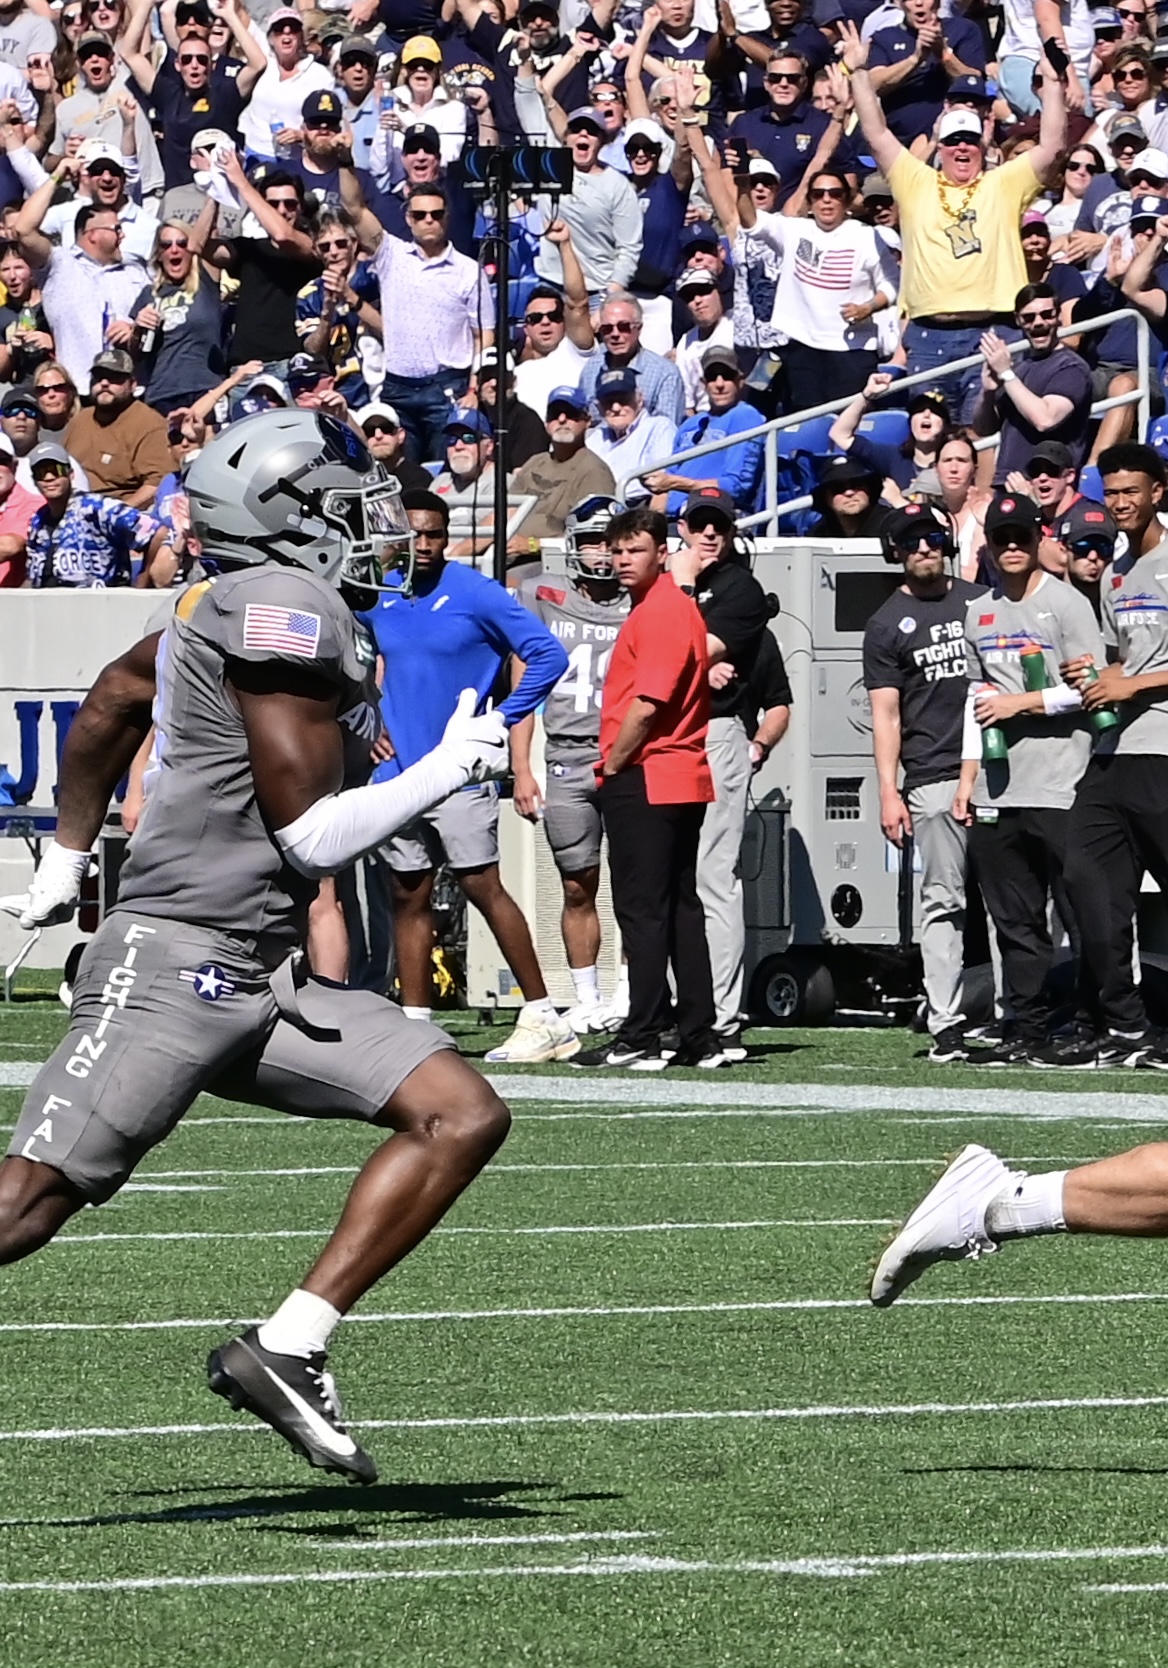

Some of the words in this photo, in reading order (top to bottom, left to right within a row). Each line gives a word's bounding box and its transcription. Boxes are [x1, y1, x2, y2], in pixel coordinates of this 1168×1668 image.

[172, 213, 234, 229] NAY
[945, 218, 982, 259] N
[550, 620, 576, 638] AIR
[583, 623, 619, 641] FOR
[930, 620, 964, 643] F-16
[913, 638, 967, 667] FIGHTI
[986, 651, 1003, 664] AIR
[924, 659, 968, 682] FALC
[337, 702, 377, 743] AIR
[65, 923, 156, 1078] FIGHTING
[22, 1094, 71, 1162] FAL
